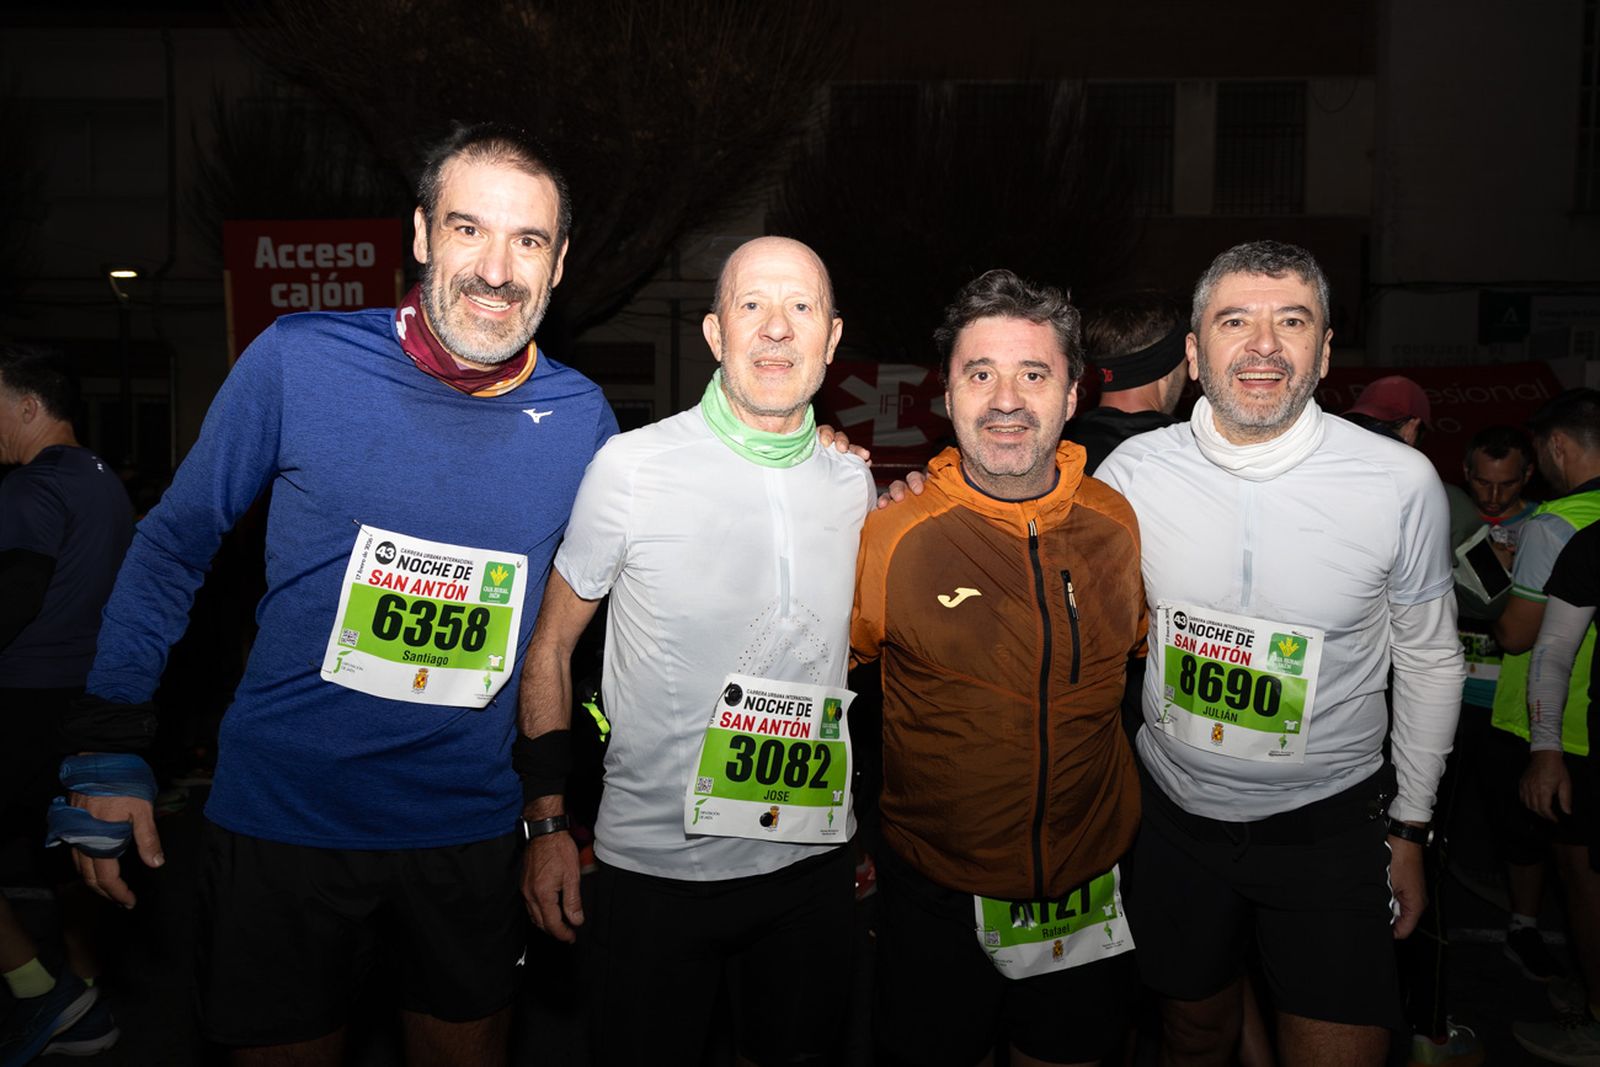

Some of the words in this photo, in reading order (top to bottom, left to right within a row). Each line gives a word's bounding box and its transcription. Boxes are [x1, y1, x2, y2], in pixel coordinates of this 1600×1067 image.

[253, 235, 377, 270] Acceso
[269, 271, 365, 312] cajón
[879, 393, 915, 416] IFP
[375, 545, 396, 561] 43
[396, 554, 452, 579] NOCHE
[452, 564, 474, 581] DE
[368, 569, 408, 592] SAN
[409, 579, 469, 602] ANTÓN
[371, 593, 491, 653] 6358
[1173, 614, 1187, 626] 43
[1188, 622, 1234, 644] NOCHE
[1235, 633, 1255, 648] DE
[402, 650, 449, 667] Santiago
[1174, 633, 1197, 654] SAN
[1198, 643, 1253, 667] ANTÓN
[1179, 654, 1283, 718] 8690
[743, 695, 795, 717] NOCHE
[796, 703, 813, 718] DE
[1202, 705, 1239, 723] JULIÁN
[719, 711, 757, 732] SAN
[757, 717, 811, 739] ANTÓN
[725, 734, 832, 789] 3082
[763, 790, 790, 802] JOSE
[1041, 923, 1071, 938] Rafael
